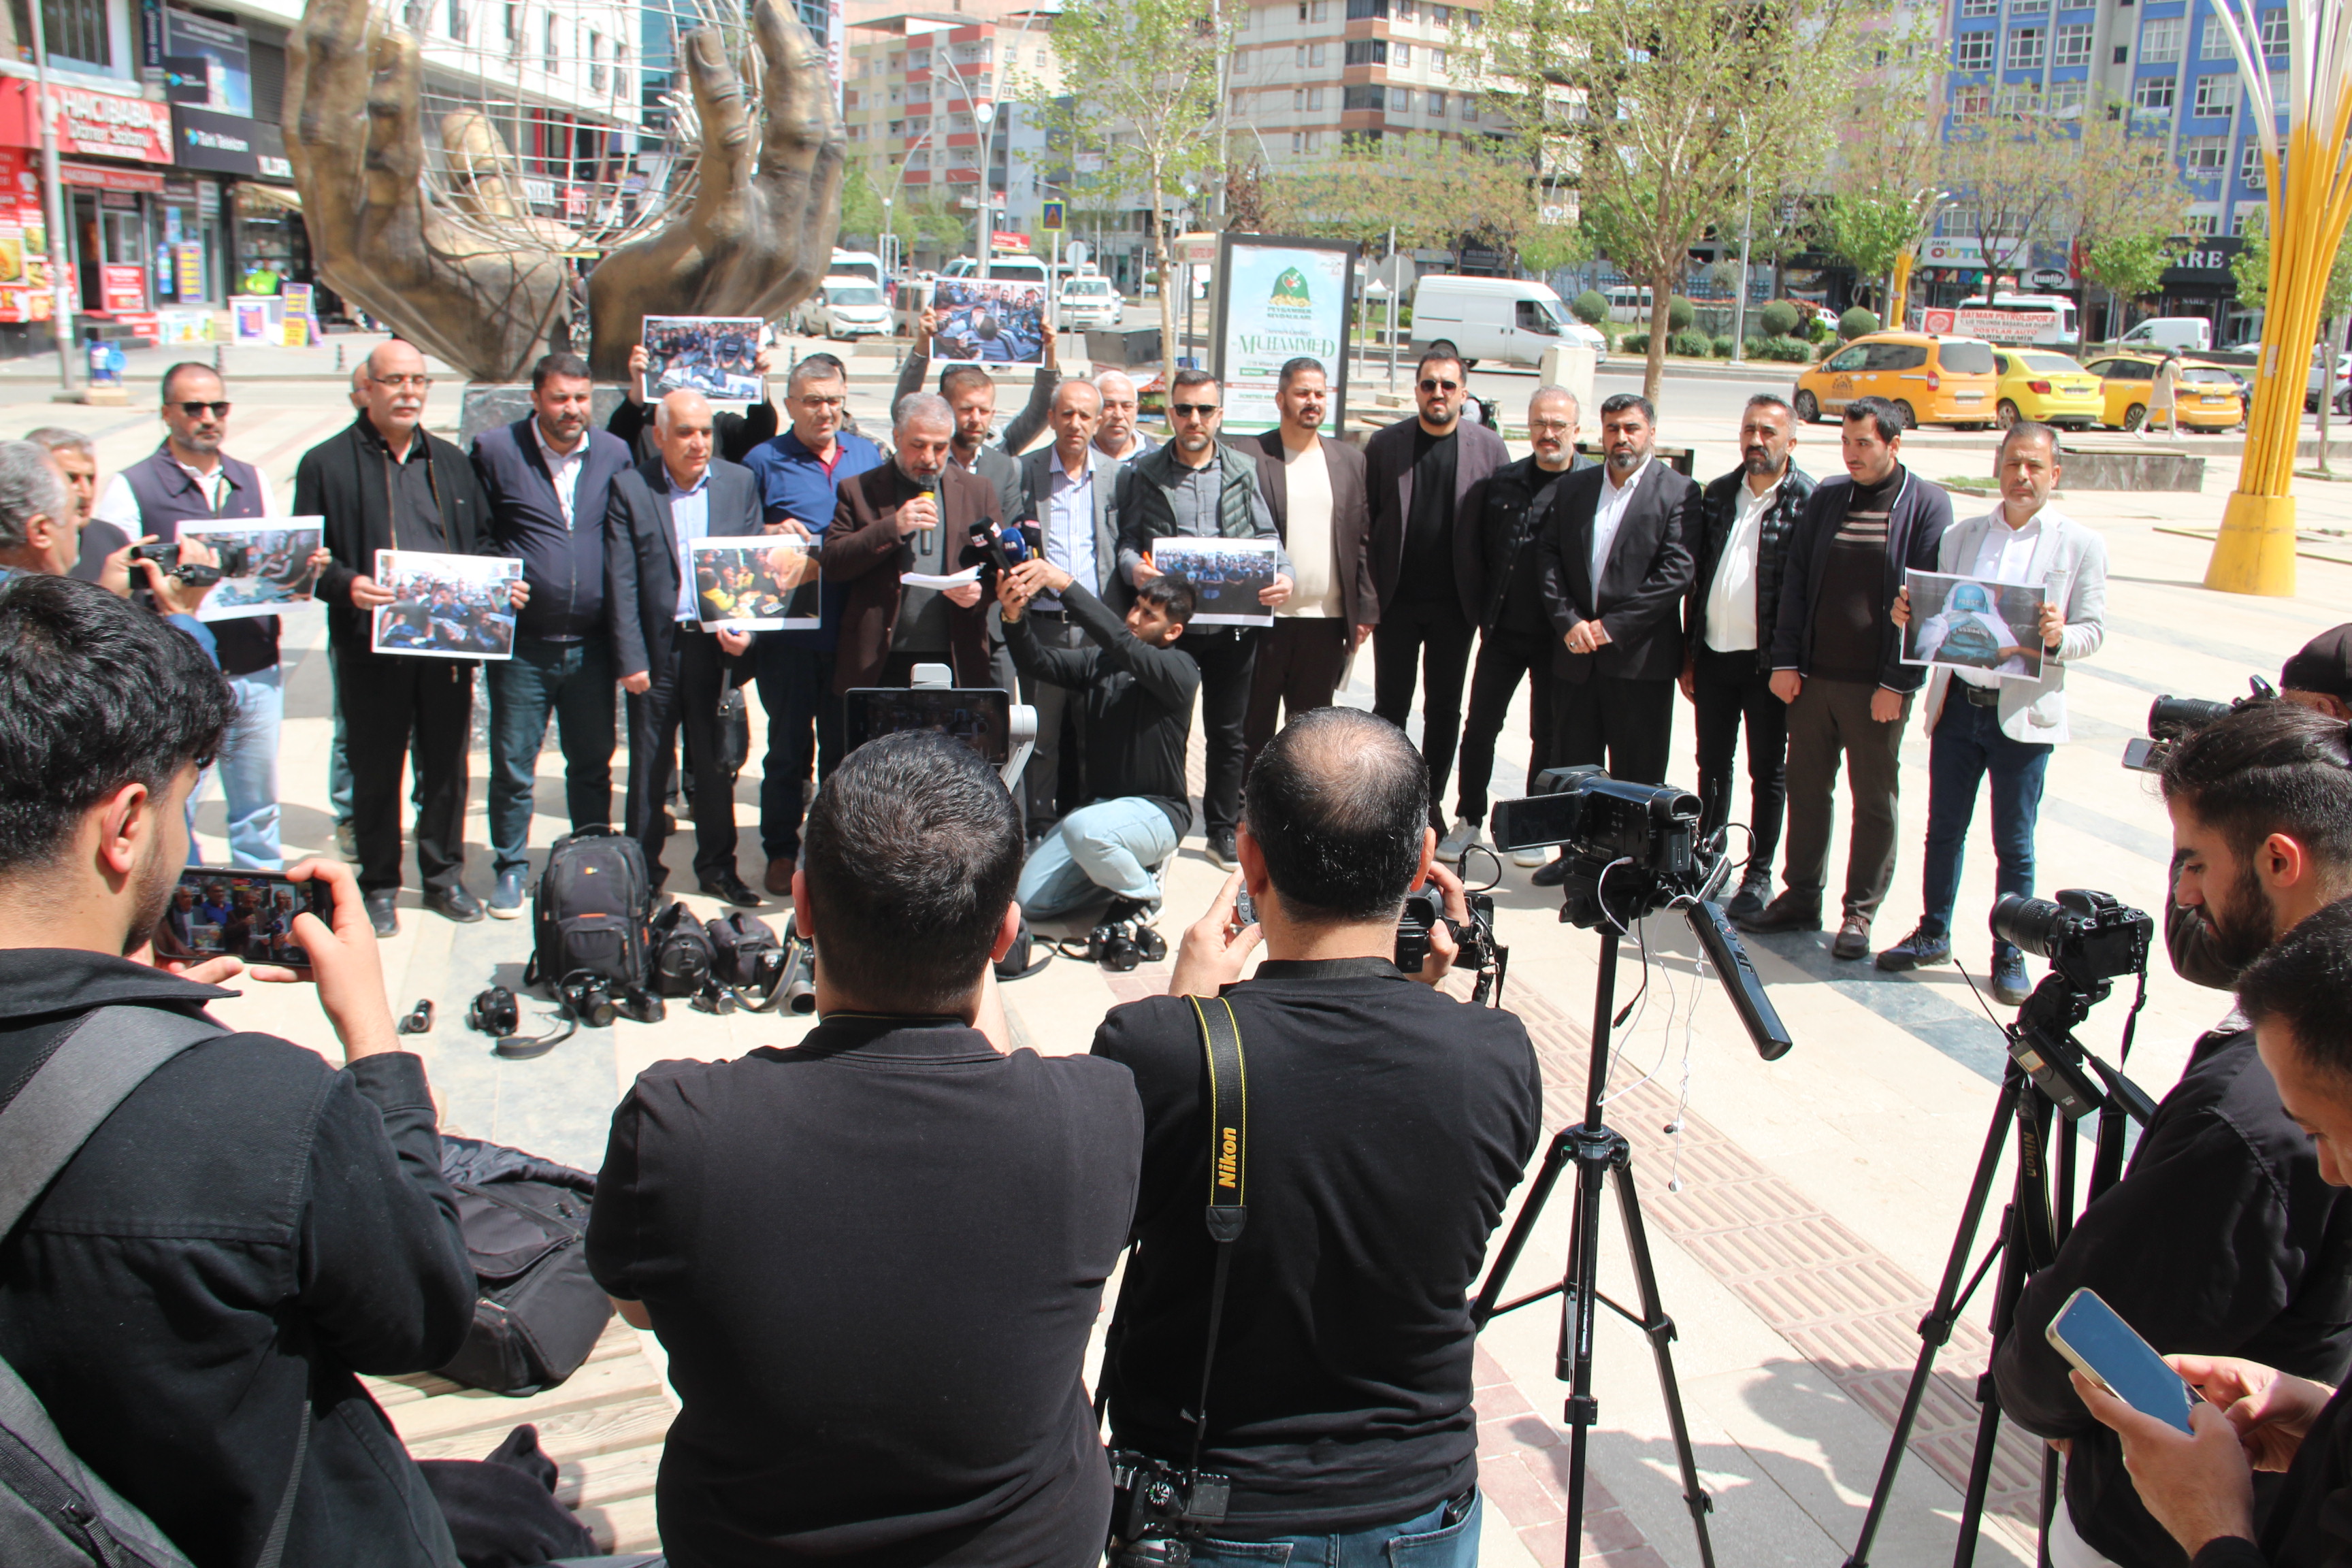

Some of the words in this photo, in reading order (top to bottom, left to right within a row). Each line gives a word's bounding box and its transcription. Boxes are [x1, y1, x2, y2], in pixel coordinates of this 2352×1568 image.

[1961, 310, 1993, 319] BATMAN
[1239, 335, 1335, 357] MUHAMMED
[1218, 1127, 1237, 1188] Nikon
[2023, 1131, 2037, 1177] Nikon
